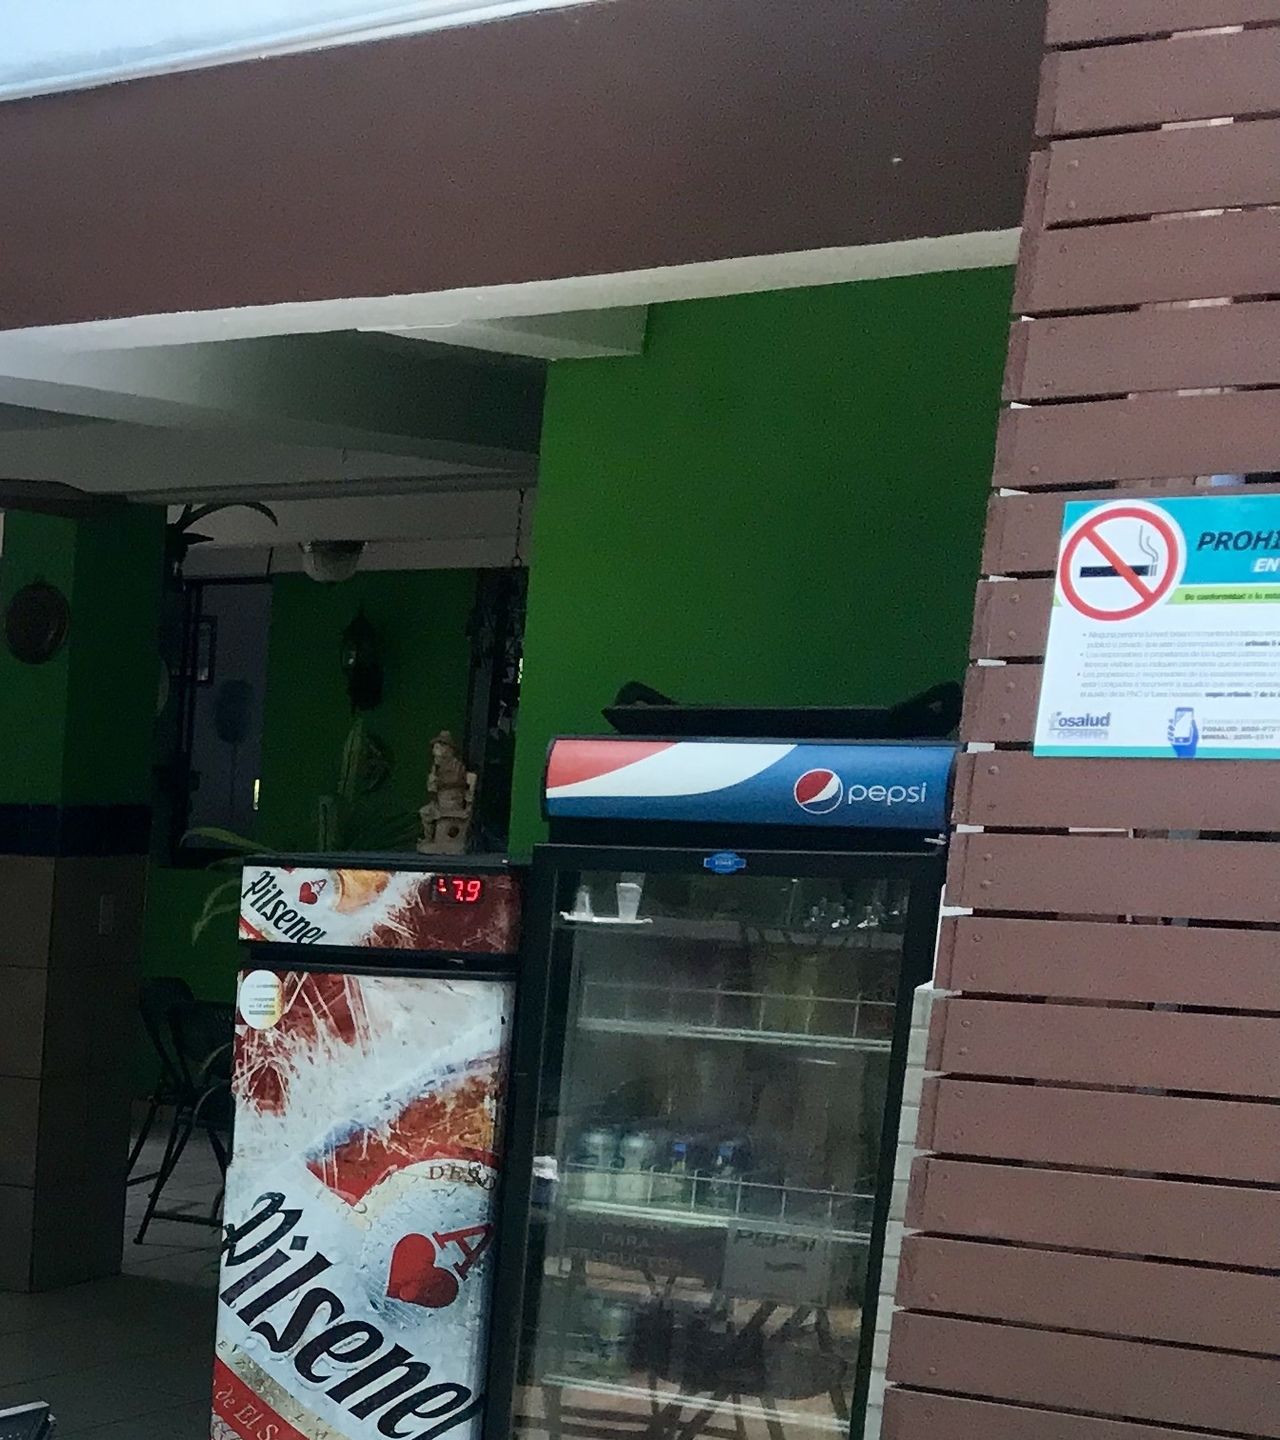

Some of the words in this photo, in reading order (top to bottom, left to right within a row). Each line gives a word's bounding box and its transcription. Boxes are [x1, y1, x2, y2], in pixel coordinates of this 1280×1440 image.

[1253, 557, 1279, 573] EN
[847, 782, 927, 807] pepsi
[435, 1224, 493, 1281] A
[215, 1383, 236, 1409] de
[233, 1403, 265, 1431] El
